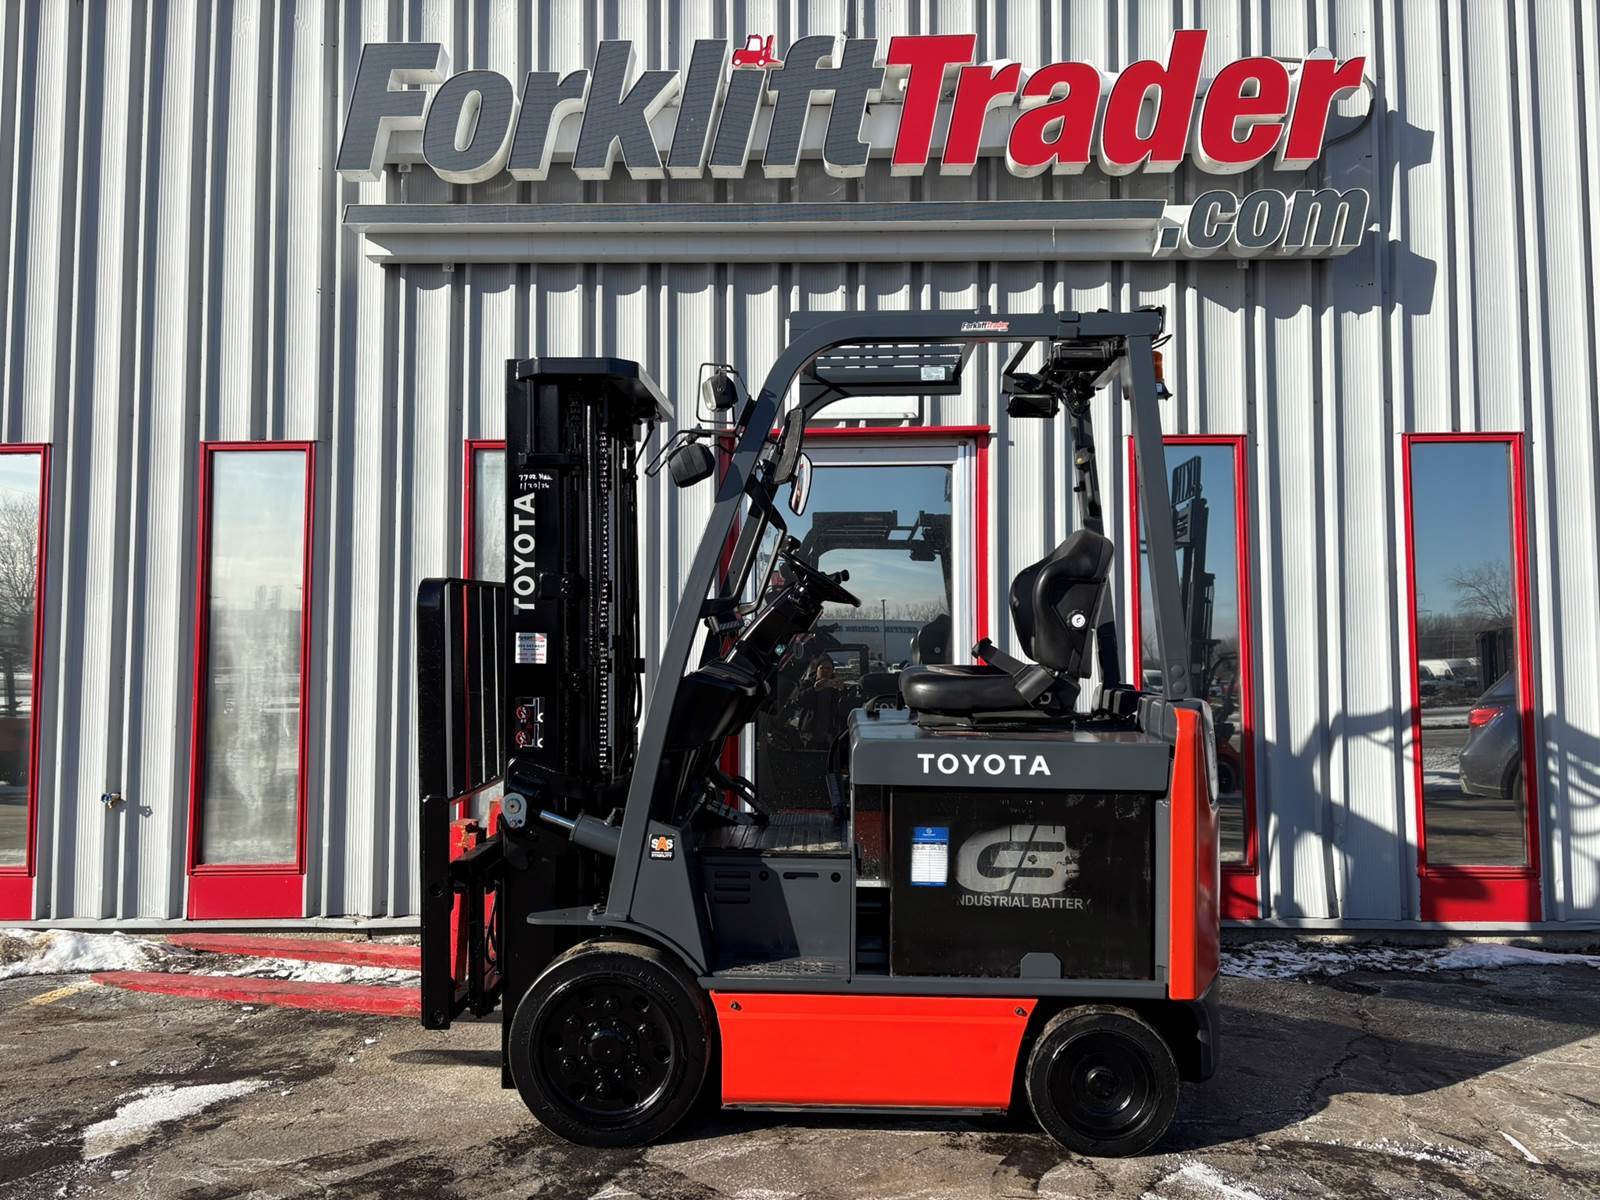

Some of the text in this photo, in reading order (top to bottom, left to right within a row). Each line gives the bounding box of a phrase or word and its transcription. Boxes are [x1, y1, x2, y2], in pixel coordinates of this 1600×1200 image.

[513, 492, 535, 615] TOYOTA
[917, 753, 1051, 776] TOYOTA
[650, 836, 674, 851] SAS
[957, 894, 1091, 910] NDUSTRIAL BATTER
